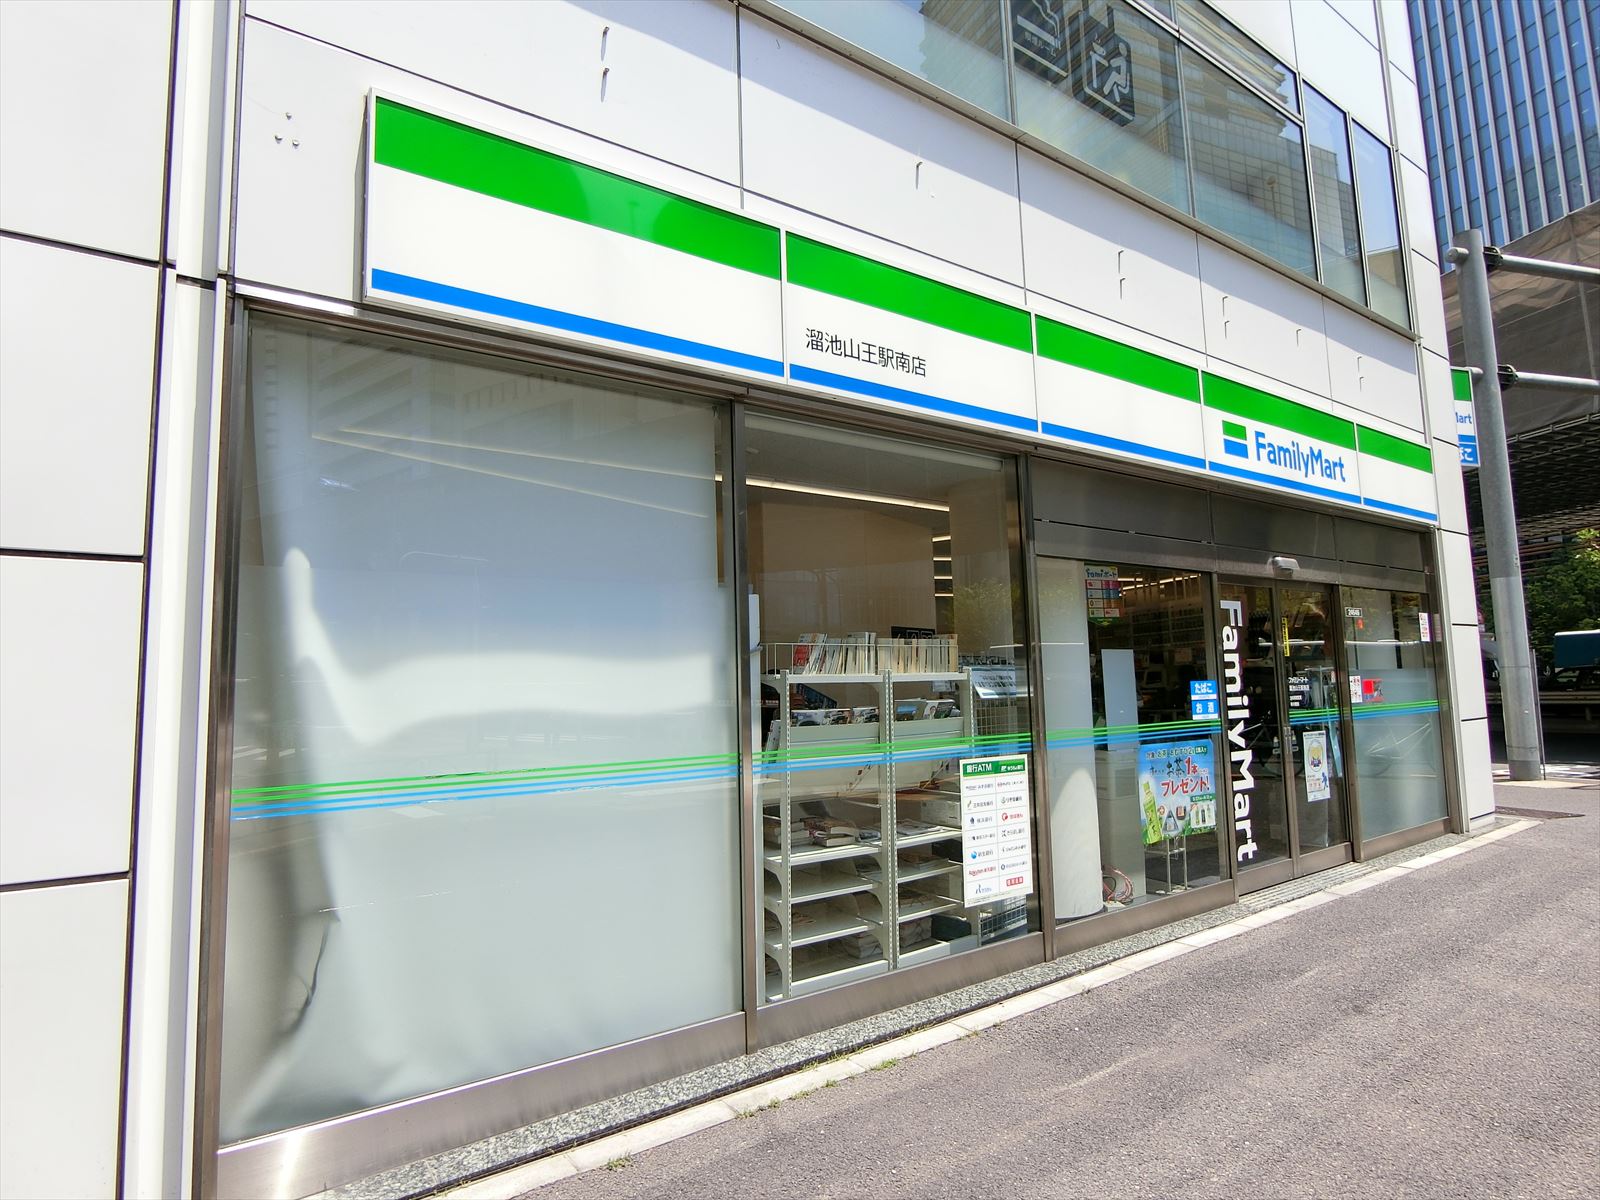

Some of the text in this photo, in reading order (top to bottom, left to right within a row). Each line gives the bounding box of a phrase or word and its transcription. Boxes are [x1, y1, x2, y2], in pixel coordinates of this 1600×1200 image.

[805, 327, 926, 378] 溜池山王駅南店
[1254, 430, 1346, 483] FamilyMart
[1194, 682, 1213, 694] たばこ
[1219, 599, 1259, 862] FamilyMart
